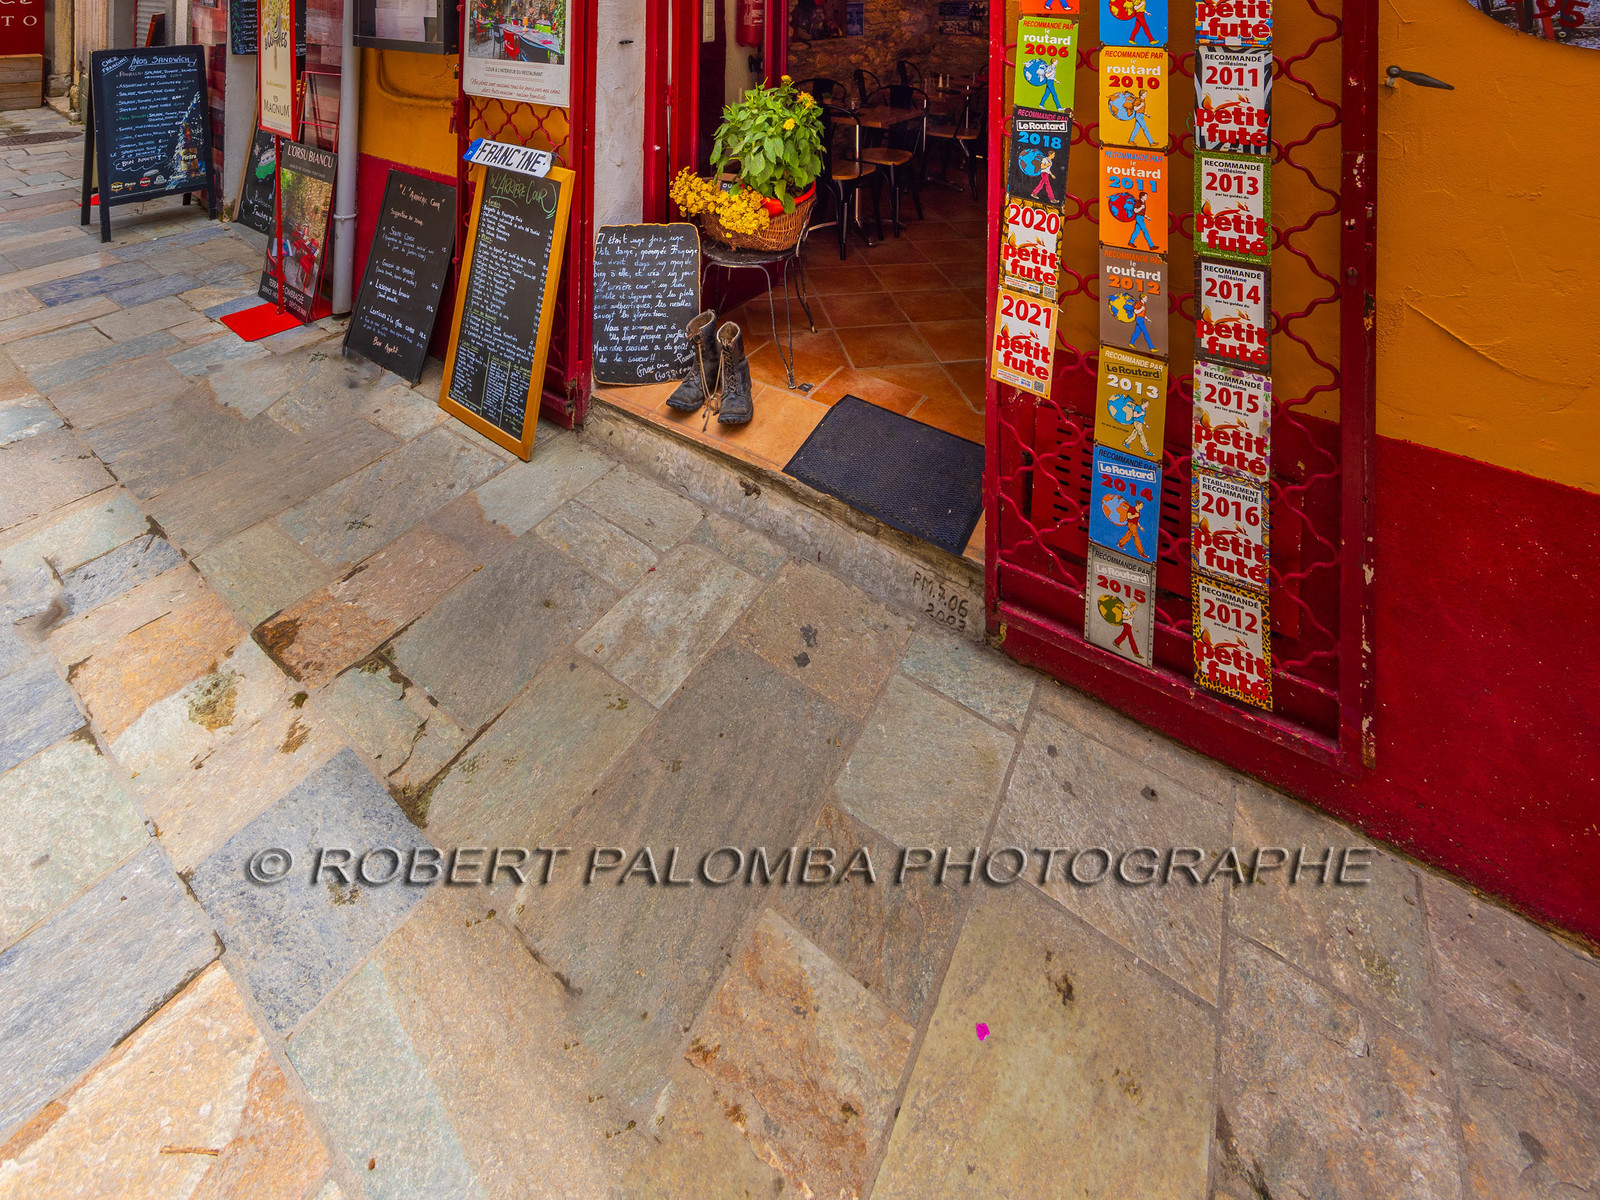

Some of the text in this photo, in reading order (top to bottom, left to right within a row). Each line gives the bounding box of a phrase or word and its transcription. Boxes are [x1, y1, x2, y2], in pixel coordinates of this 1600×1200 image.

[1024, 34, 1071, 45] routard
[1208, 17, 1271, 39] futé
[1024, 43, 1069, 58] 2006
[1204, 54, 1262, 62] RECOMMANDÉ
[1107, 65, 1160, 75] routard
[1205, 65, 1258, 87] 2011
[1108, 75, 1160, 89] 2010
[263, 98, 290, 118] MAGNUM
[1196, 106, 1269, 128] petit
[1029, 122, 1065, 130] Routard
[1206, 123, 1269, 147] futé
[1018, 131, 1062, 149] 2018
[287, 144, 335, 168] L'ORSU BIANCU
[1204, 160, 1261, 171] RECOMMANDÉ
[1106, 166, 1161, 179] routard
[1109, 175, 1157, 193] 2011
[1205, 172, 1259, 196] 2013
[1008, 203, 1060, 235] 2020
[1196, 213, 1268, 237] petit
[1206, 229, 1268, 257] futé
[1003, 243, 1058, 269] petit
[1106, 265, 1161, 281] routard
[1204, 265, 1261, 280] RECOMMANDÉ
[1218, 274, 1247, 282] millésime
[1108, 274, 1160, 296] 2012
[1205, 277, 1261, 305] 2014
[1000, 294, 1052, 329] 2021
[1196, 319, 1269, 347] petit
[995, 334, 1051, 364] petit
[1206, 336, 1269, 365] futé
[1119, 366, 1160, 378] Routard
[1150, 363, 1163, 372] PAR
[1107, 374, 1159, 399] 2013
[1204, 370, 1261, 390] RECOMMANDÉ
[1204, 383, 1259, 414] 2015
[1194, 424, 1268, 457] petit
[1205, 441, 1267, 476] futé
[1112, 466, 1154, 481] Routard
[1100, 474, 1154, 501] 2014
[1202, 477, 1259, 498] ÉTABLISSEMENT
[1202, 483, 1259, 505] RECOMMANDÉ
[1201, 491, 1260, 527] 2016
[1194, 528, 1267, 565] petit
[1108, 567, 1147, 584] Routard
[1204, 547, 1266, 584] futé
[1097, 575, 1146, 603] 2015
[1202, 585, 1259, 610] RECOMMANDÉ
[1203, 598, 1258, 634] 2012
[1195, 640, 1268, 679] petit
[1207, 660, 1269, 700] futé
